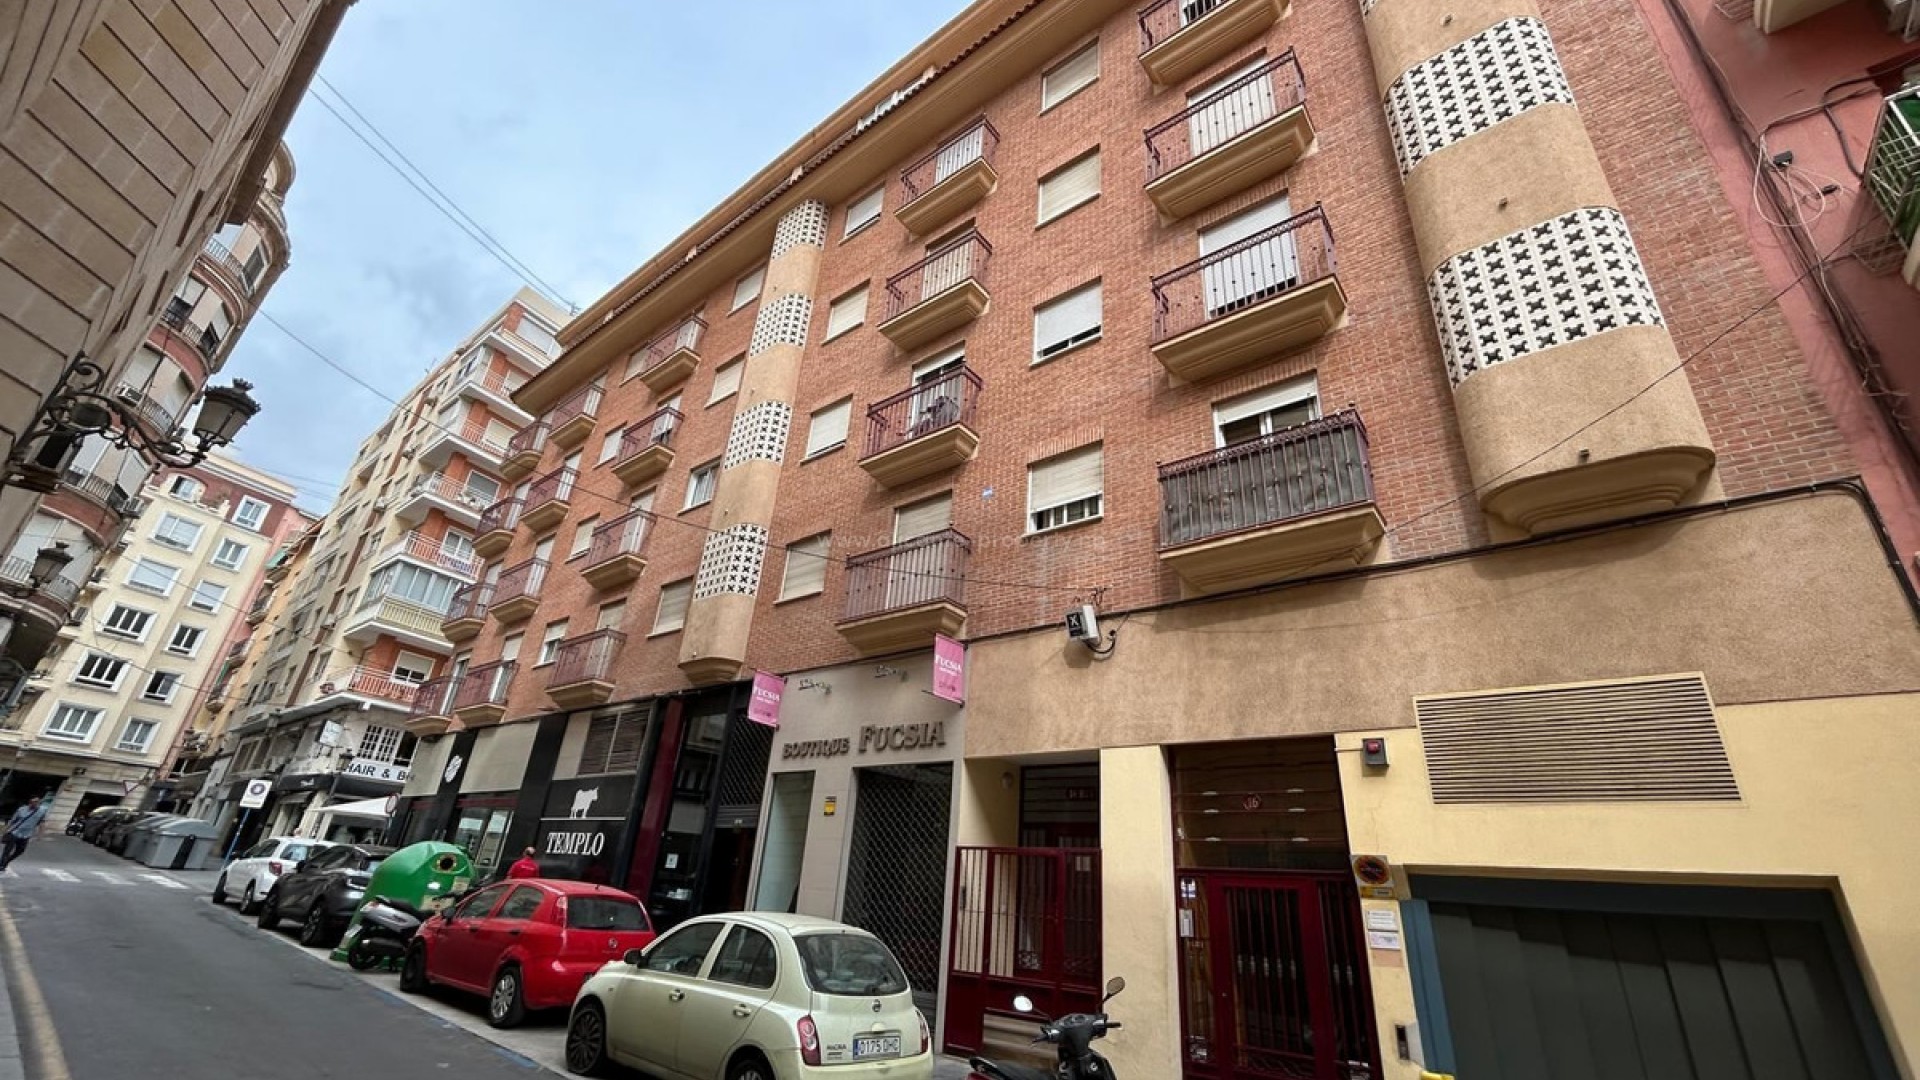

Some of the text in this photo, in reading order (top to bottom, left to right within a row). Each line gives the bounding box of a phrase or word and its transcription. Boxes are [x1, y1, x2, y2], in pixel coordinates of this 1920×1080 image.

[782, 721, 947, 760] BOUTIQUE FUCSIA
[546, 832, 605, 856] TEMPLO
